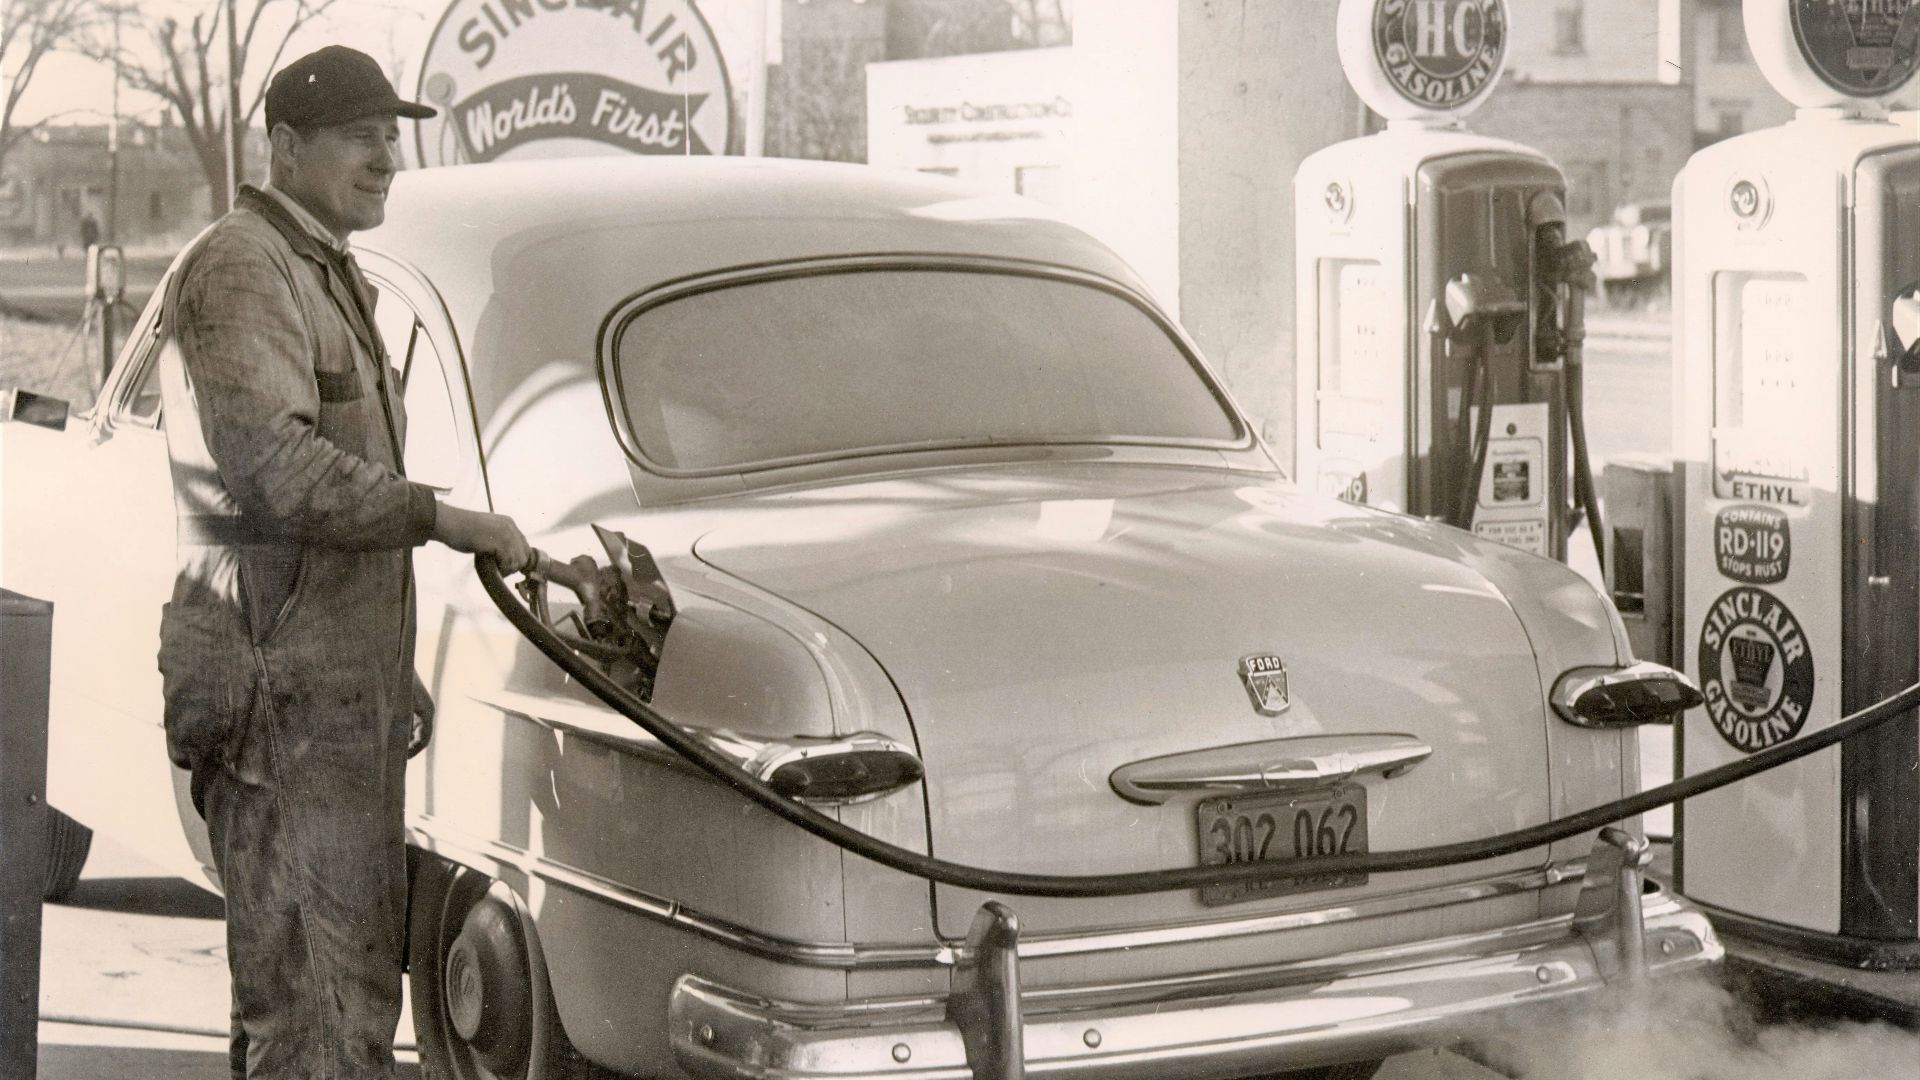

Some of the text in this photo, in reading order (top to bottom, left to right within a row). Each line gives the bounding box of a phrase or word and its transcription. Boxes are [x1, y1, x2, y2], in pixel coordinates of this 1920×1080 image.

[458, 0, 697, 85] SINAIR
[1386, 42, 1497, 101] GASOLINE
[467, 84, 683, 153] World's First
[1722, 509, 1781, 530] CONTAINS
[1733, 481, 1799, 505] ETHYL
[1722, 556, 1783, 578] STOPS RUST
[1704, 592, 1804, 664] SINCLAIR
[1250, 656, 1280, 671] FORD
[1705, 679, 1802, 748] GASOLINE
[1210, 803, 1358, 864] 302 062
